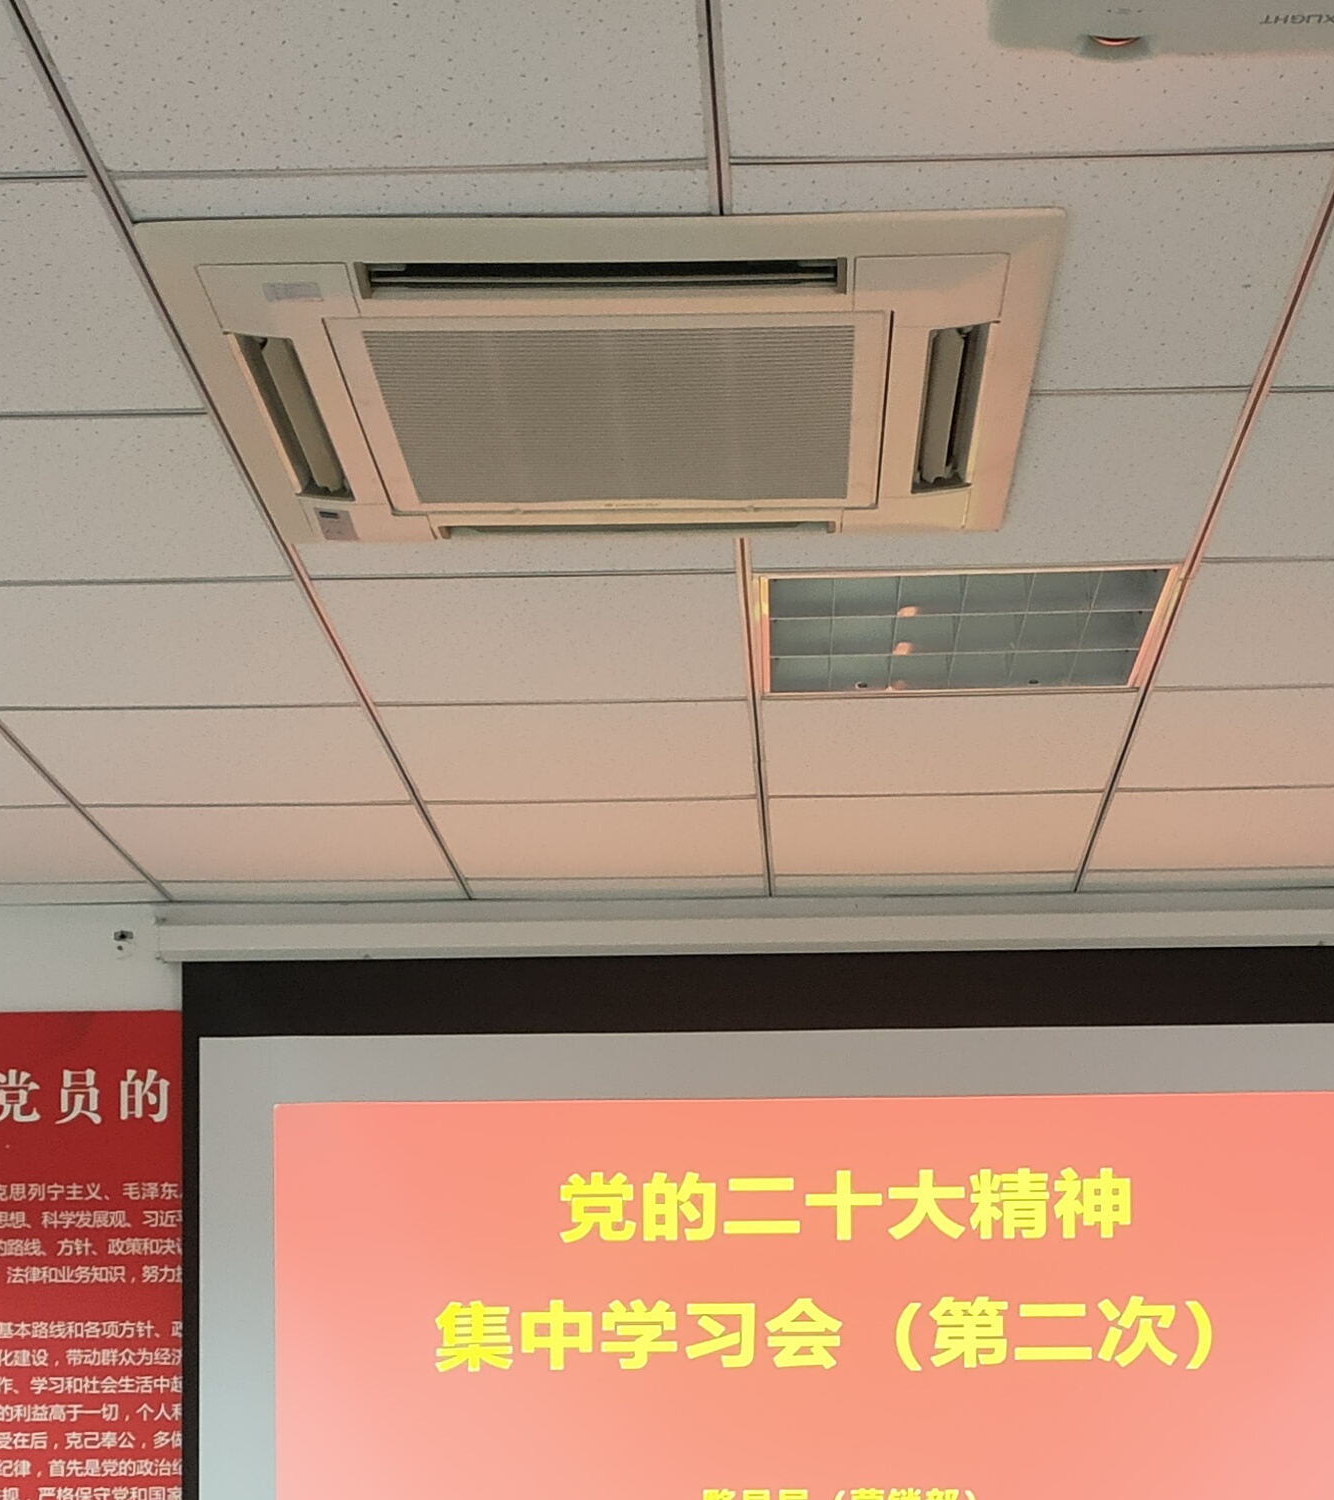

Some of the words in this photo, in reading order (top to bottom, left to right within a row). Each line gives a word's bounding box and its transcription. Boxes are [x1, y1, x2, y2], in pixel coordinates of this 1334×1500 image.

[559, 1168, 1132, 1243] 党的二十大精神
[435, 1296, 1213, 1373] 集中学习会（第二次）
